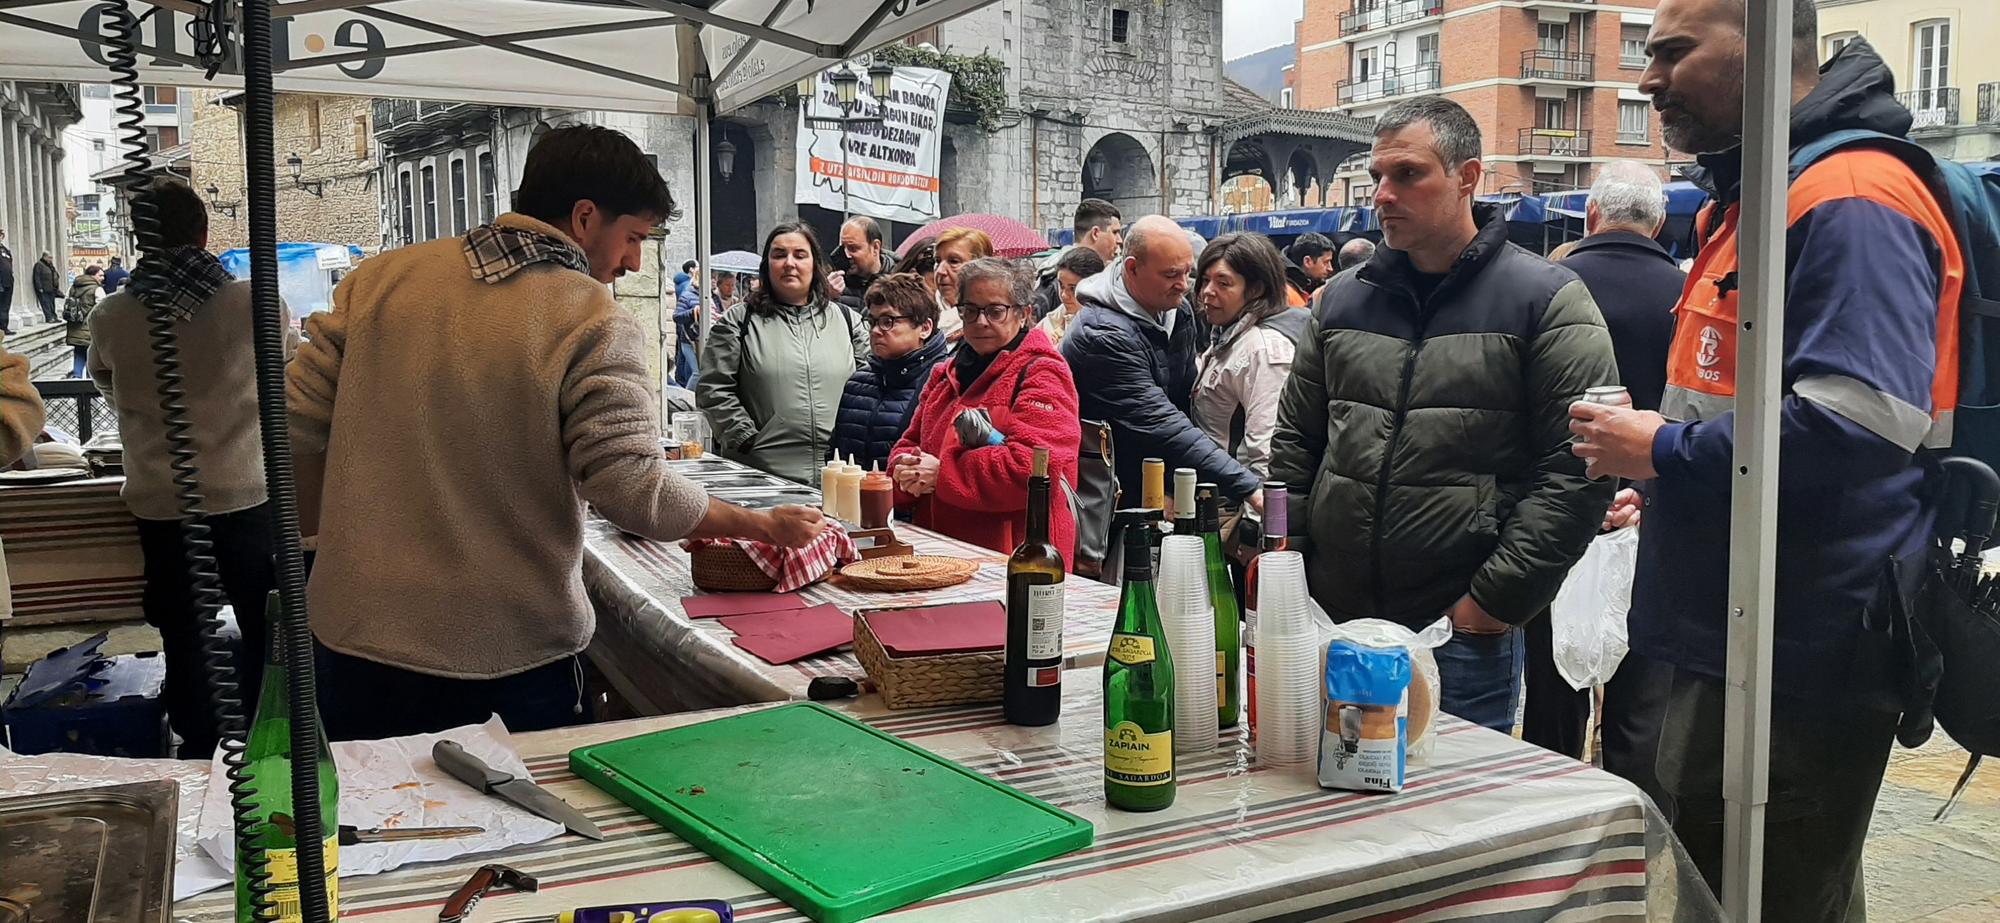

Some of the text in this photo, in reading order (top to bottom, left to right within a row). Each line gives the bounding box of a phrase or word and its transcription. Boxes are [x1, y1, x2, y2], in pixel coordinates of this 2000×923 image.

[864, 102, 908, 125] DEAGUN
[881, 126, 921, 148] DEZAGUN
[869, 144, 916, 167] ALTXORRA
[1109, 739, 1150, 751] ZAPIAIN
[1119, 773, 1168, 782] SAGARDOA
[1364, 776, 1391, 789] Fina
